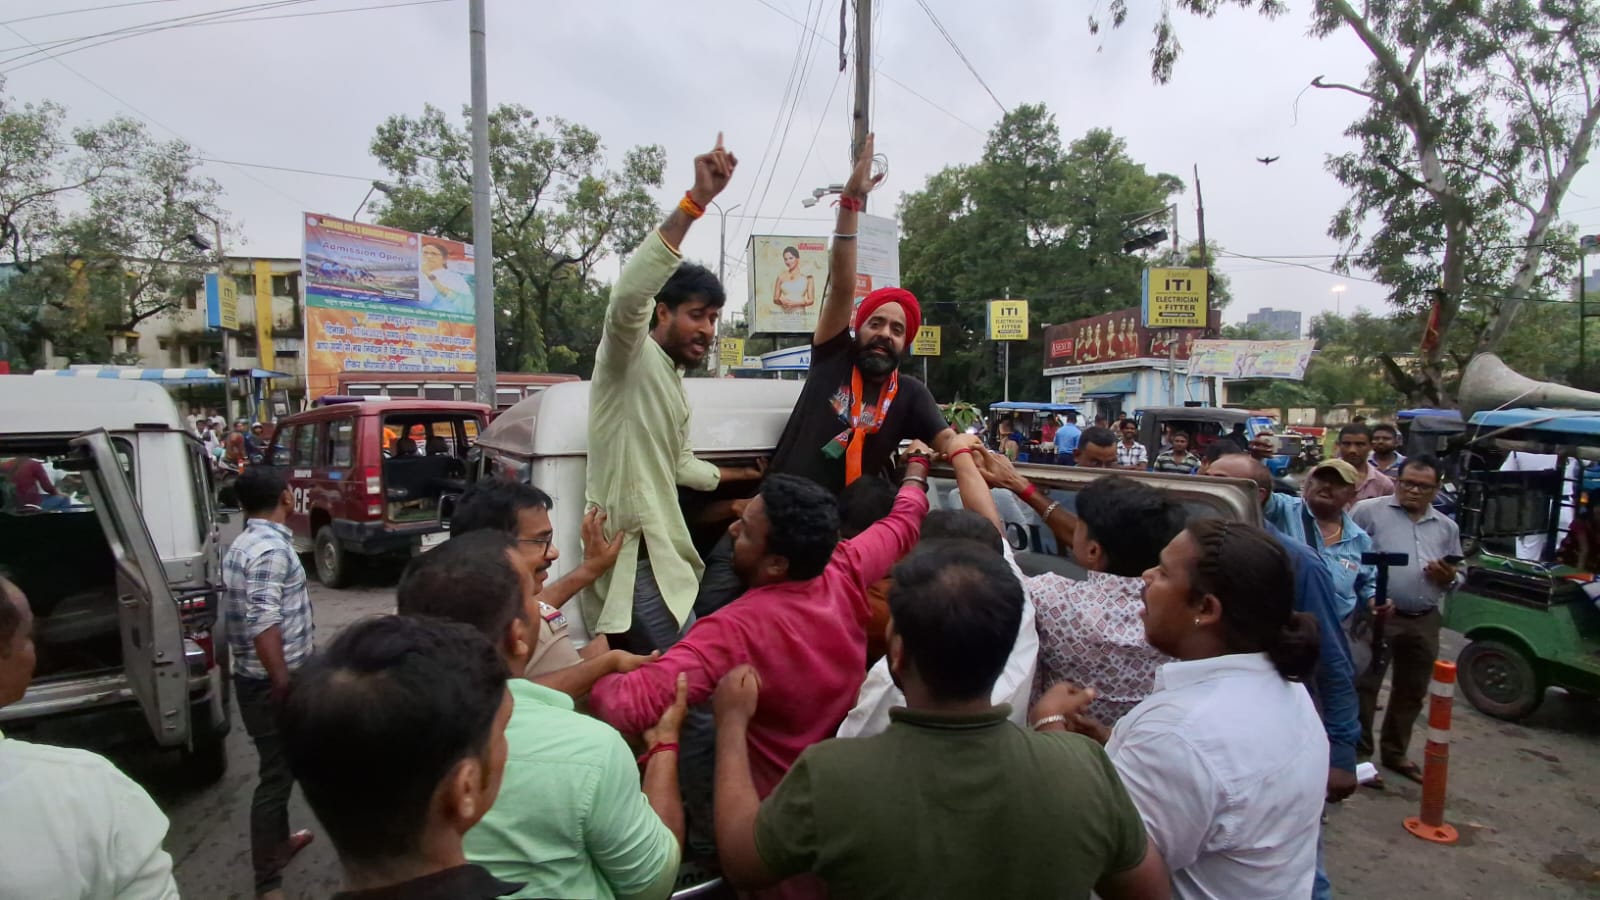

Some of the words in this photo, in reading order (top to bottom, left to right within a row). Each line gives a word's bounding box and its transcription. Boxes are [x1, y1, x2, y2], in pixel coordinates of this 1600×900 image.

[322, 241, 376, 257] Admission
[378, 250, 404, 263] Open
[1165, 279, 1192, 291] ITI
[1001, 307, 1018, 316] ITI
